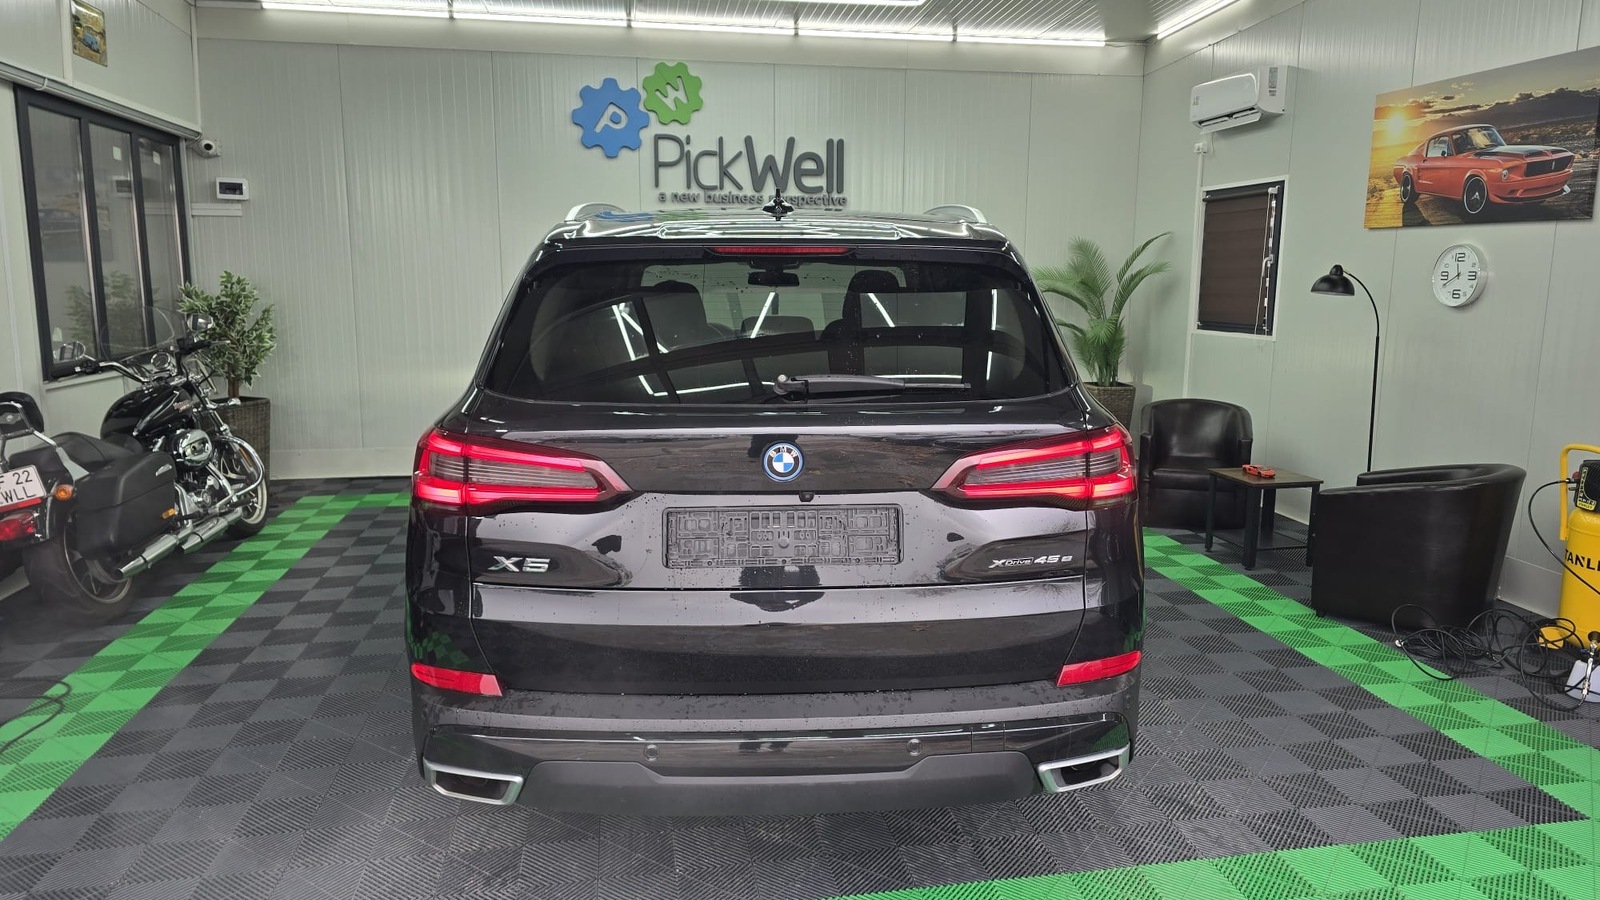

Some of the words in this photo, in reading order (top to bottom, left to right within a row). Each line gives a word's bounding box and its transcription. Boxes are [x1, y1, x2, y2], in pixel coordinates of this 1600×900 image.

[653, 133, 845, 194] PickWell
[658, 191, 667, 203] a
[671, 191, 701, 203] new
[704, 190, 764, 206] business
[1455, 252, 1466, 262] 12
[1440, 271, 1449, 280] 9
[1467, 271, 1477, 280] 3
[1451, 289, 1461, 299] 6
[13, 470, 33, 485] 22
[487, 555, 551, 573] X5
